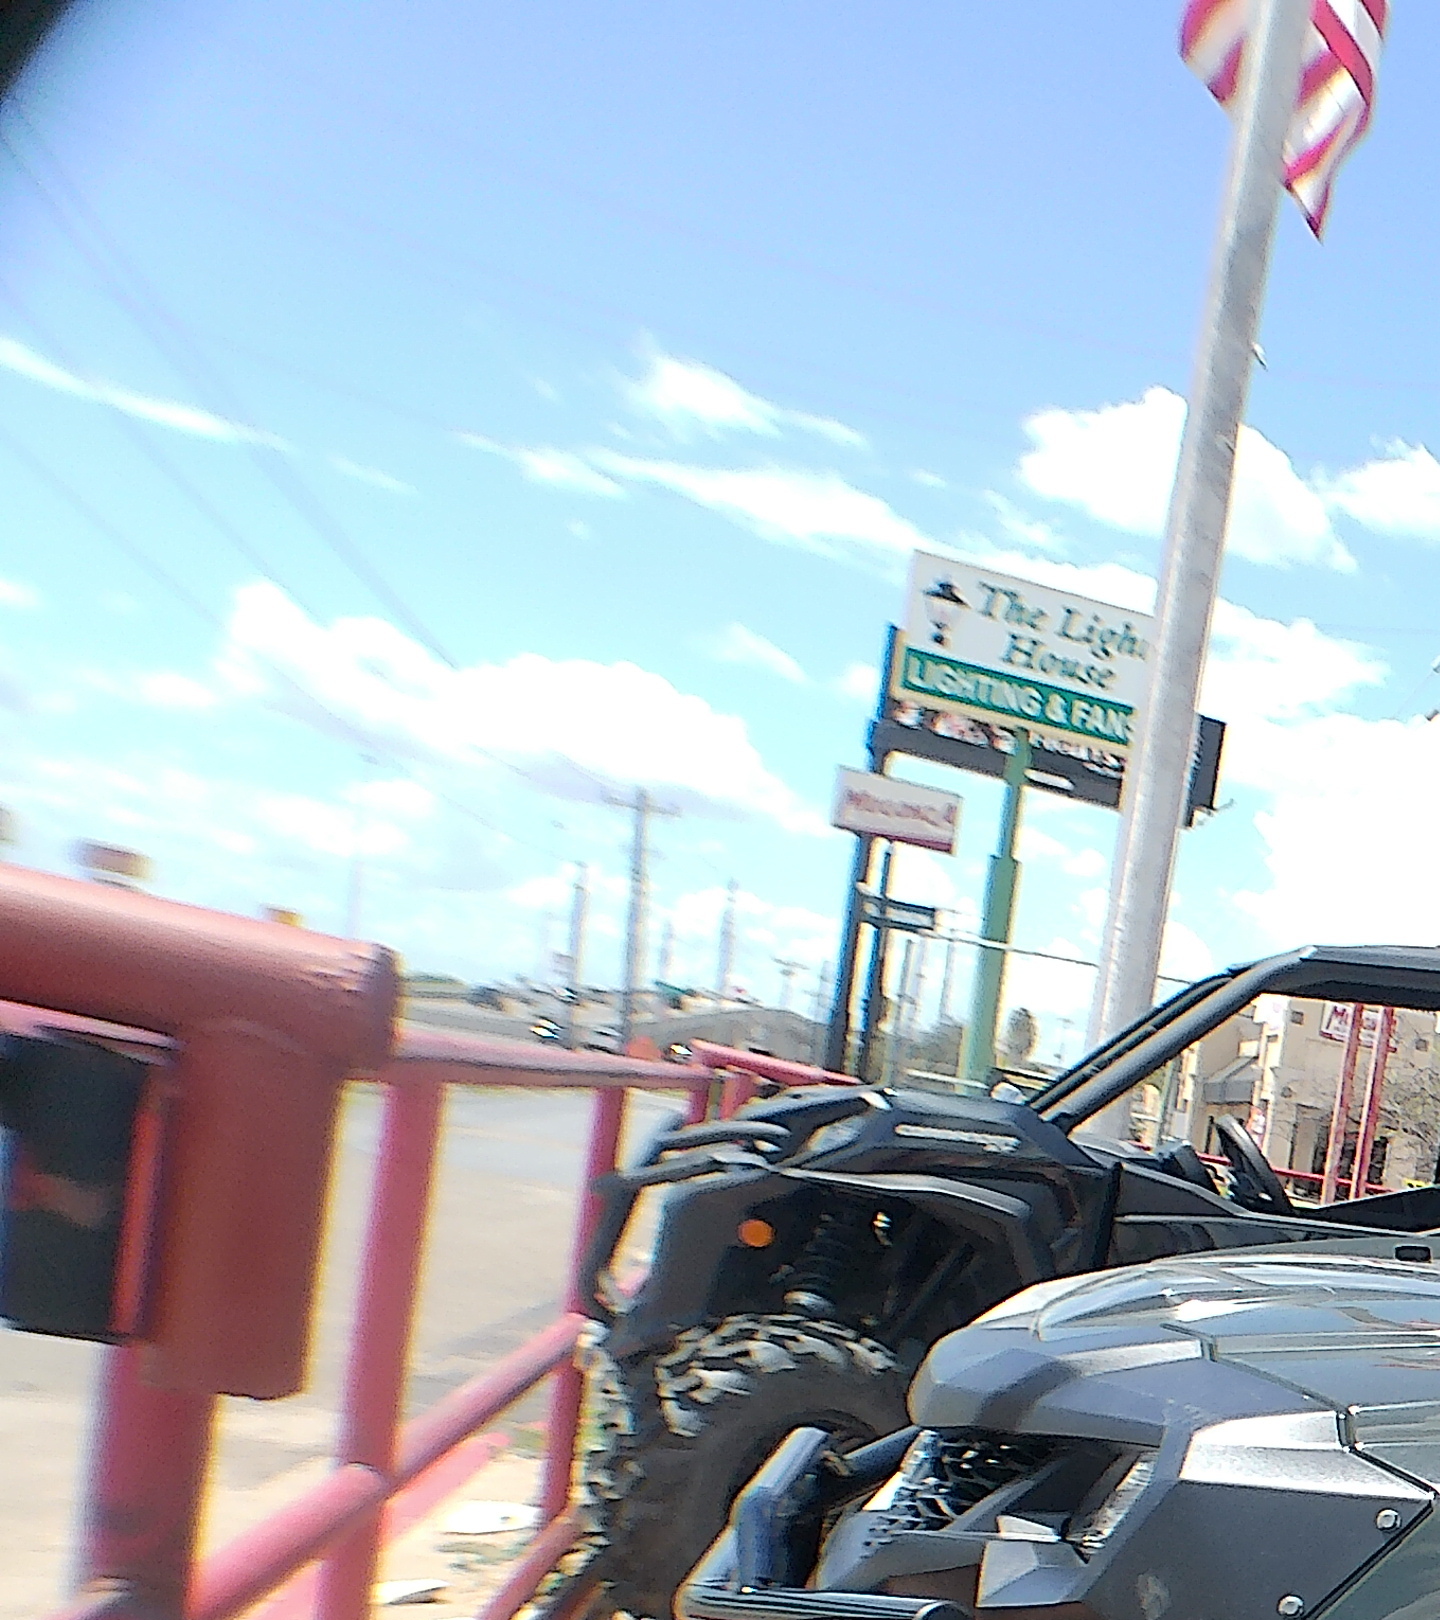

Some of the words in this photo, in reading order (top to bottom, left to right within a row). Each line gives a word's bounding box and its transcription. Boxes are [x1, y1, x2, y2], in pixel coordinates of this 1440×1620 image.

[978, 581, 1050, 631] The
[1002, 633, 1117, 690] House
[908, 656, 1044, 719] LIGHTING
[1044, 693, 1068, 725] &
